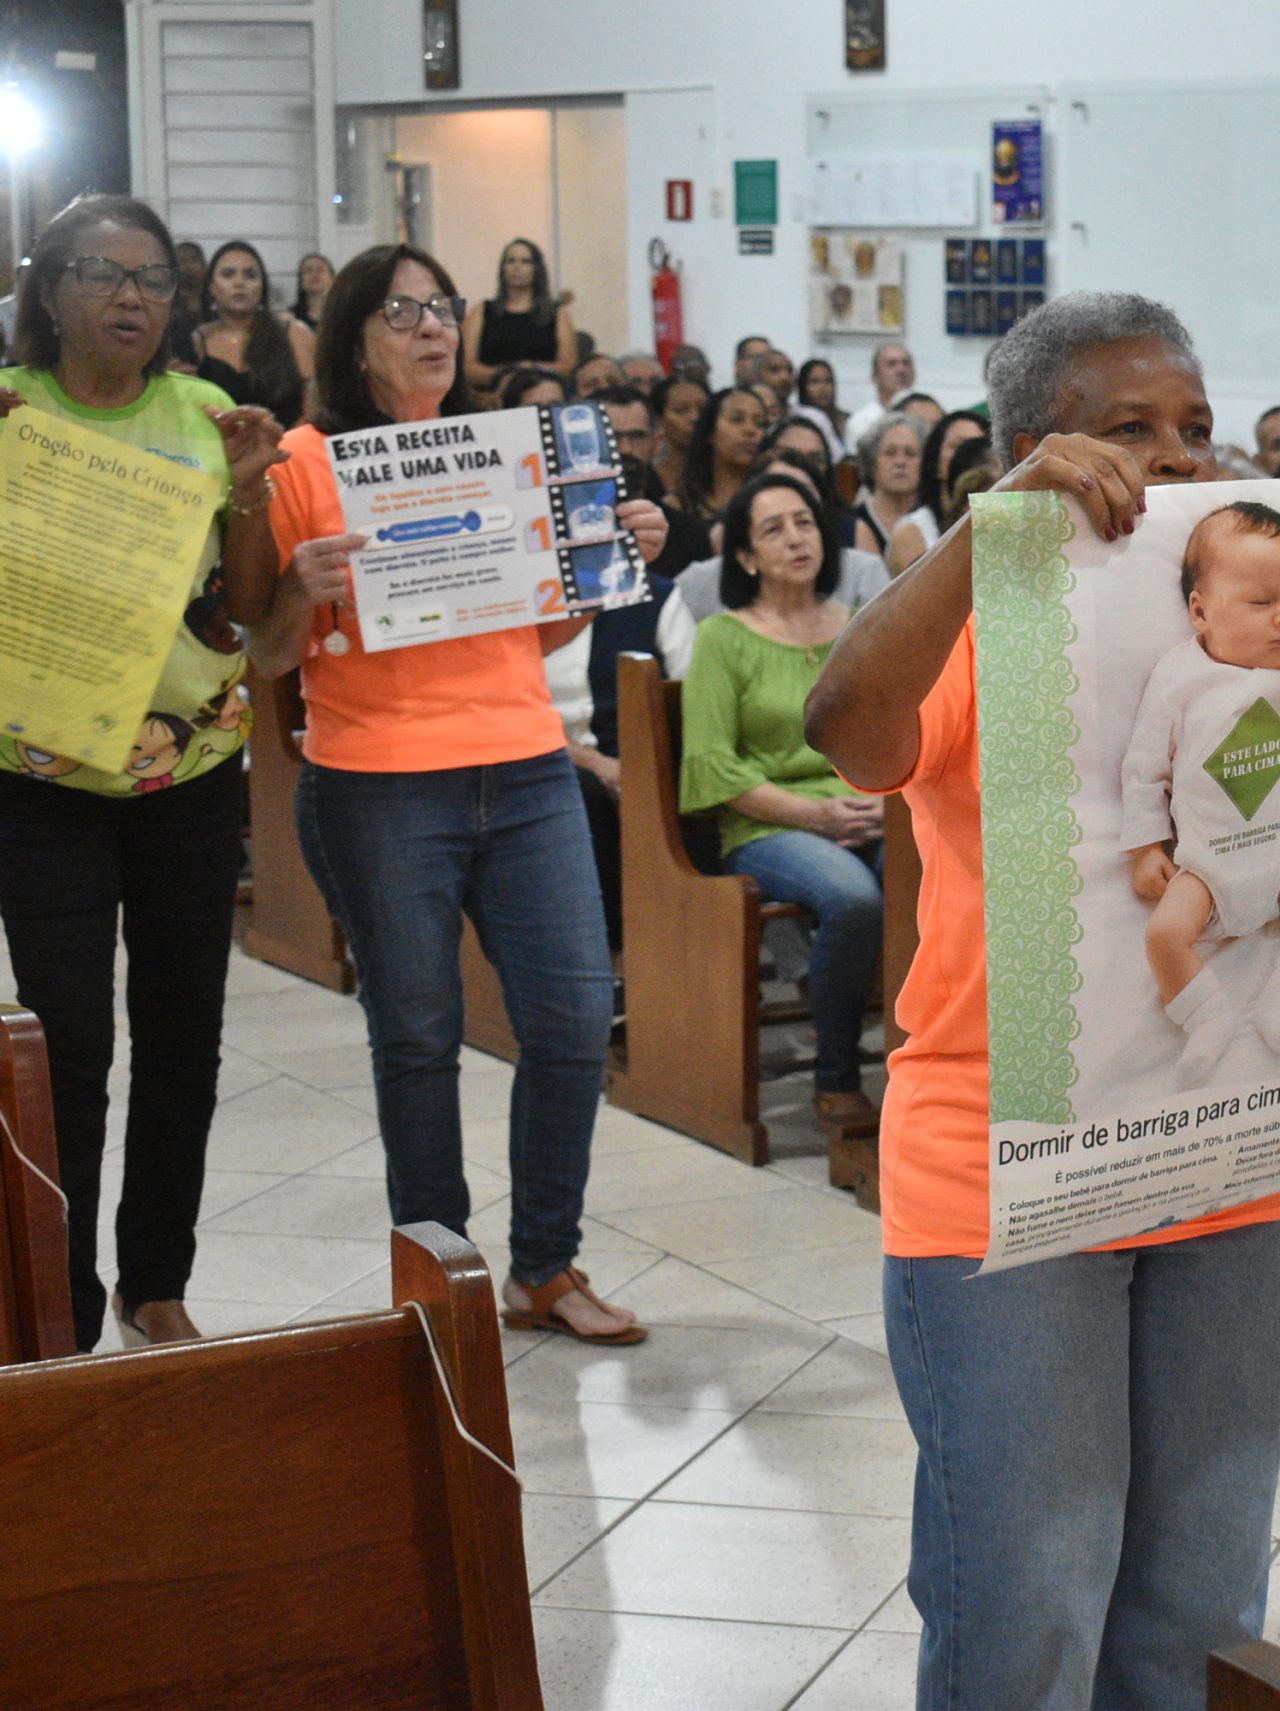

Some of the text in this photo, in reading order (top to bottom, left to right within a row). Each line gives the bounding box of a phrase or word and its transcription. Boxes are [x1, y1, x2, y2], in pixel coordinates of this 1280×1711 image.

[395, 424, 475, 452] RECEITA
[18, 424, 85, 462] Oração
[87, 454, 128, 479] pela
[132, 467, 203, 506] Criança
[401, 456, 447, 480] UMA
[454, 448, 503, 471] VIDA
[520, 453, 543, 488] 1
[529, 516, 550, 551] 1
[537, 578, 568, 616] 2
[1223, 747, 1252, 764] ESTE
[1223, 762, 1252, 779] PARA
[998, 1130, 1075, 1166] Dormir
[1081, 1123, 1109, 1149] de
[1116, 1109, 1190, 1142] barriga
[1195, 1097, 1240, 1129] para
[1055, 1169, 1064, 1184] É
[1066, 1162, 1108, 1184] possível
[1109, 1155, 1143, 1172] reduzir
[1146, 1151, 1161, 1163] em
[1163, 1145, 1186, 1159] mais
[1187, 1140, 1201, 1152] de
[1202, 1135, 1224, 1149] 70%
[1225, 1134, 1232, 1143] a
[1234, 1126, 1261, 1141] morte
[1008, 1197, 1045, 1212] Coloque
[1054, 1192, 1069, 1202] seu
[1070, 1186, 1090, 1198] bebê
[1091, 1182, 1110, 1195] para
[1110, 1173, 1138, 1188] dormir
[1138, 1171, 1149, 1182] de
[1149, 1164, 1178, 1178] barriga
[1179, 1159, 1197, 1171] para
[1007, 1226, 1026, 1238] Não
[1008, 1214, 1027, 1226] Não
